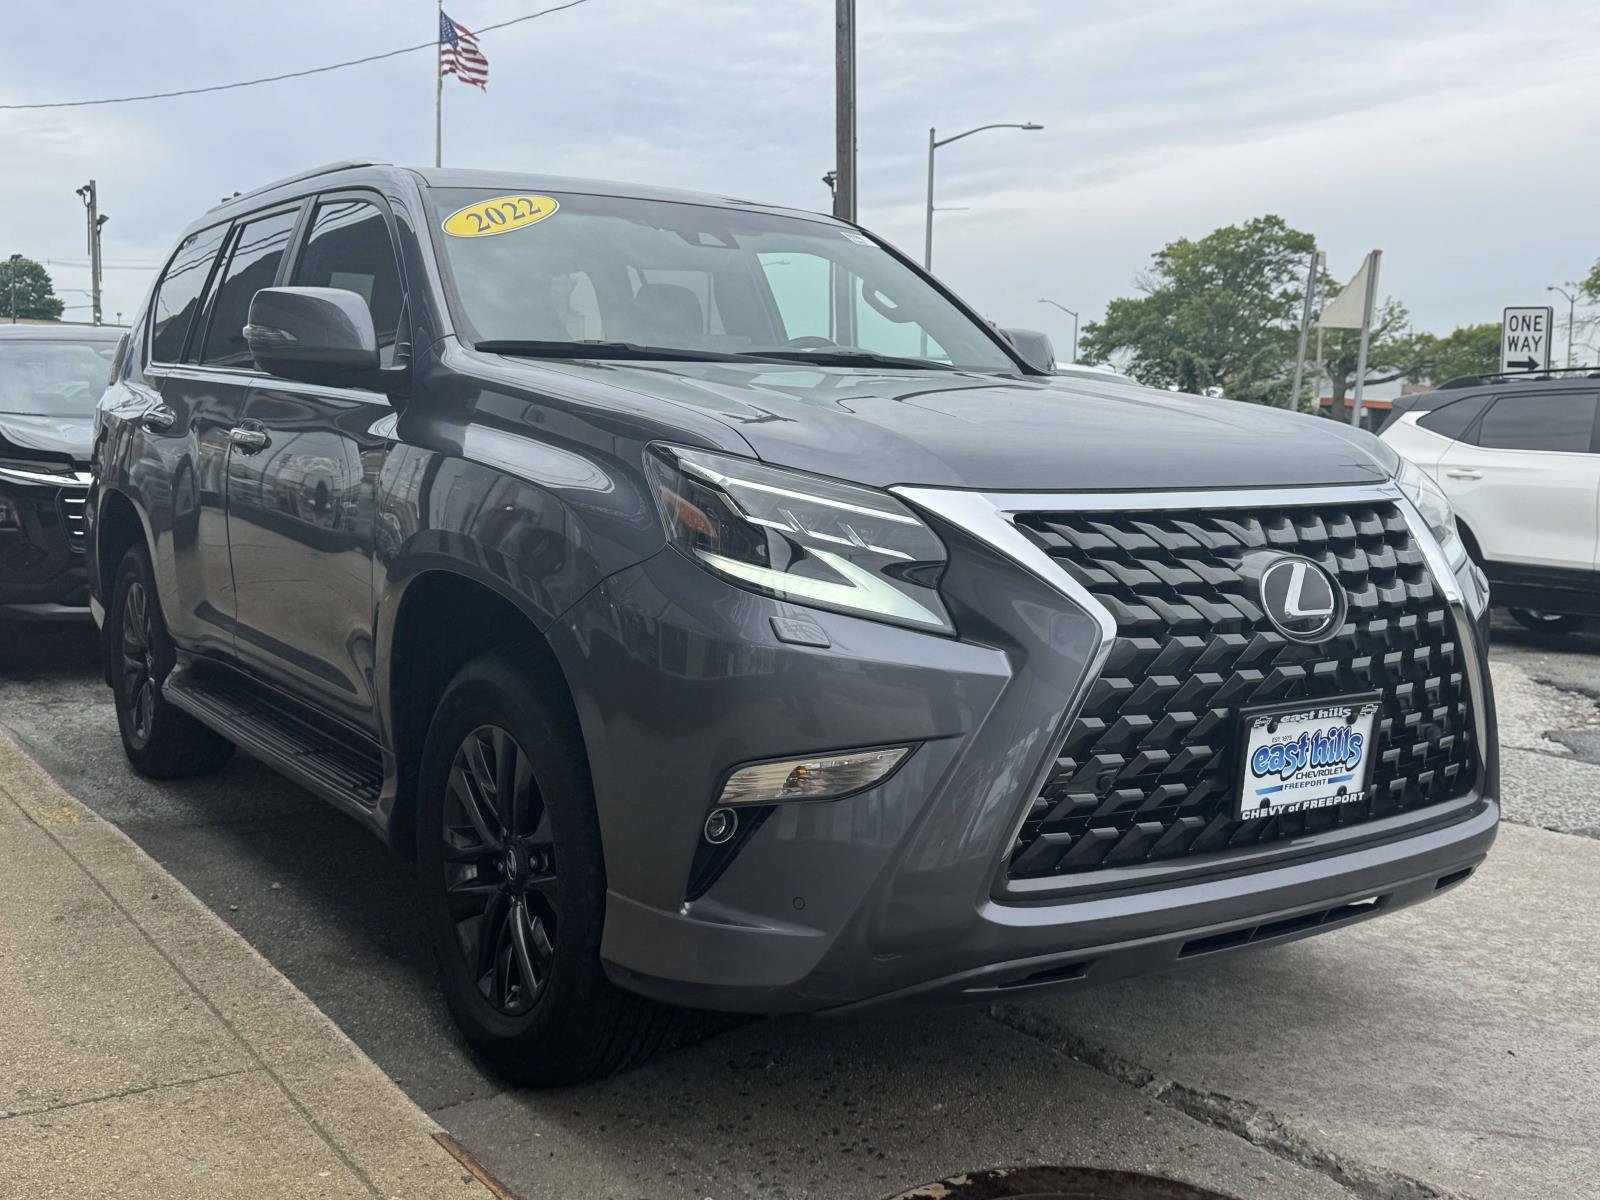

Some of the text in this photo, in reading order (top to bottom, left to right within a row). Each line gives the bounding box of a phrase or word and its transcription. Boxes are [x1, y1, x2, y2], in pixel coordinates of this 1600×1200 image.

[466, 198, 541, 232] 2022
[1509, 315, 1543, 332] ONE
[1508, 335, 1543, 352] WAY
[1280, 710, 1315, 723] east
[1318, 707, 1351, 718] hills
[1251, 726, 1363, 781] east hills
[1296, 767, 1344, 780] CHEVROLET
[1284, 779, 1327, 791] FREEPORT
[1241, 792, 1365, 821] CHEVY of FREEPORT
